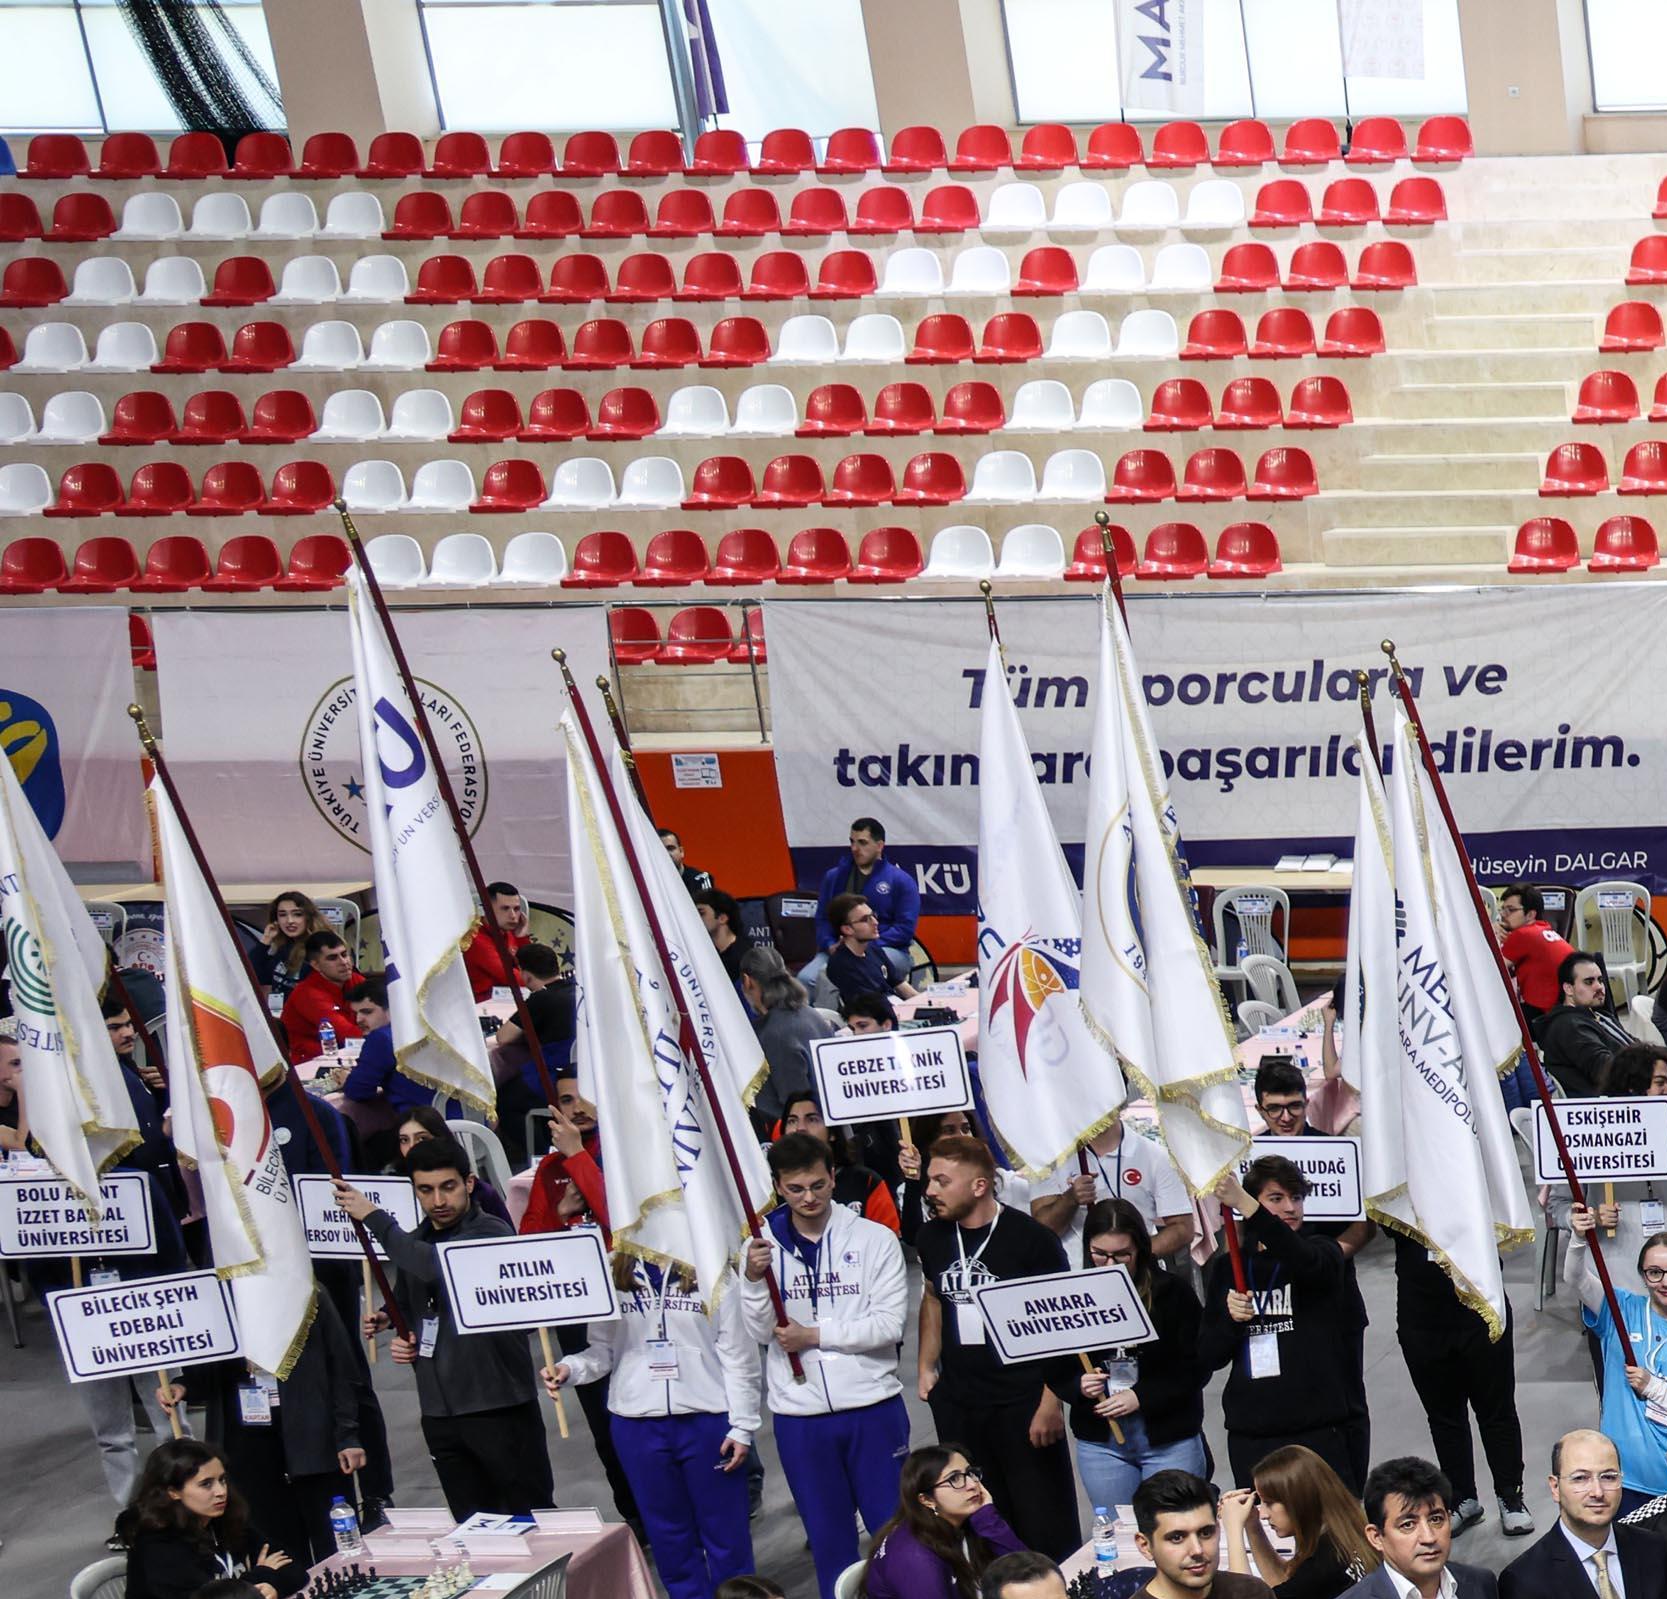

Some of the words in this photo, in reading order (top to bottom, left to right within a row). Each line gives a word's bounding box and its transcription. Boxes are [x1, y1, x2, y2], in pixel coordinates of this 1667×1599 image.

[1142, 659, 1424, 705] porculara
[1443, 662, 1507, 697] ve
[312, 767, 360, 835] TÜRKİYE
[449, 722, 478, 824] FEDERASYO
[1555, 851, 1648, 873] DALGAR
[915, 863, 971, 895] KÜ
[837, 1057, 885, 1076] GEBZE
[1567, 1106, 1642, 1128] ESKİŞEHİR
[17, 1187, 60, 1203] BOLU
[17, 1207, 60, 1225] İZZET
[18, 1226, 129, 1247] ÜNİVERSİTESİ
[308, 1229, 340, 1242] ERSOY
[499, 1259, 555, 1280] ATILIM
[81, 1289, 152, 1317] BİLECİK
[154, 1284, 200, 1310] ŞEYH
[475, 1277, 589, 1306] ÜNİVERSİTESİ
[1024, 1292, 1097, 1316] ANKARA
[109, 1310, 185, 1338] EDEBALİ
[1007, 1303, 1129, 1338] ÜNİVERSİTESİ
[92, 1329, 215, 1365] ÜNİVERSİTESİ
